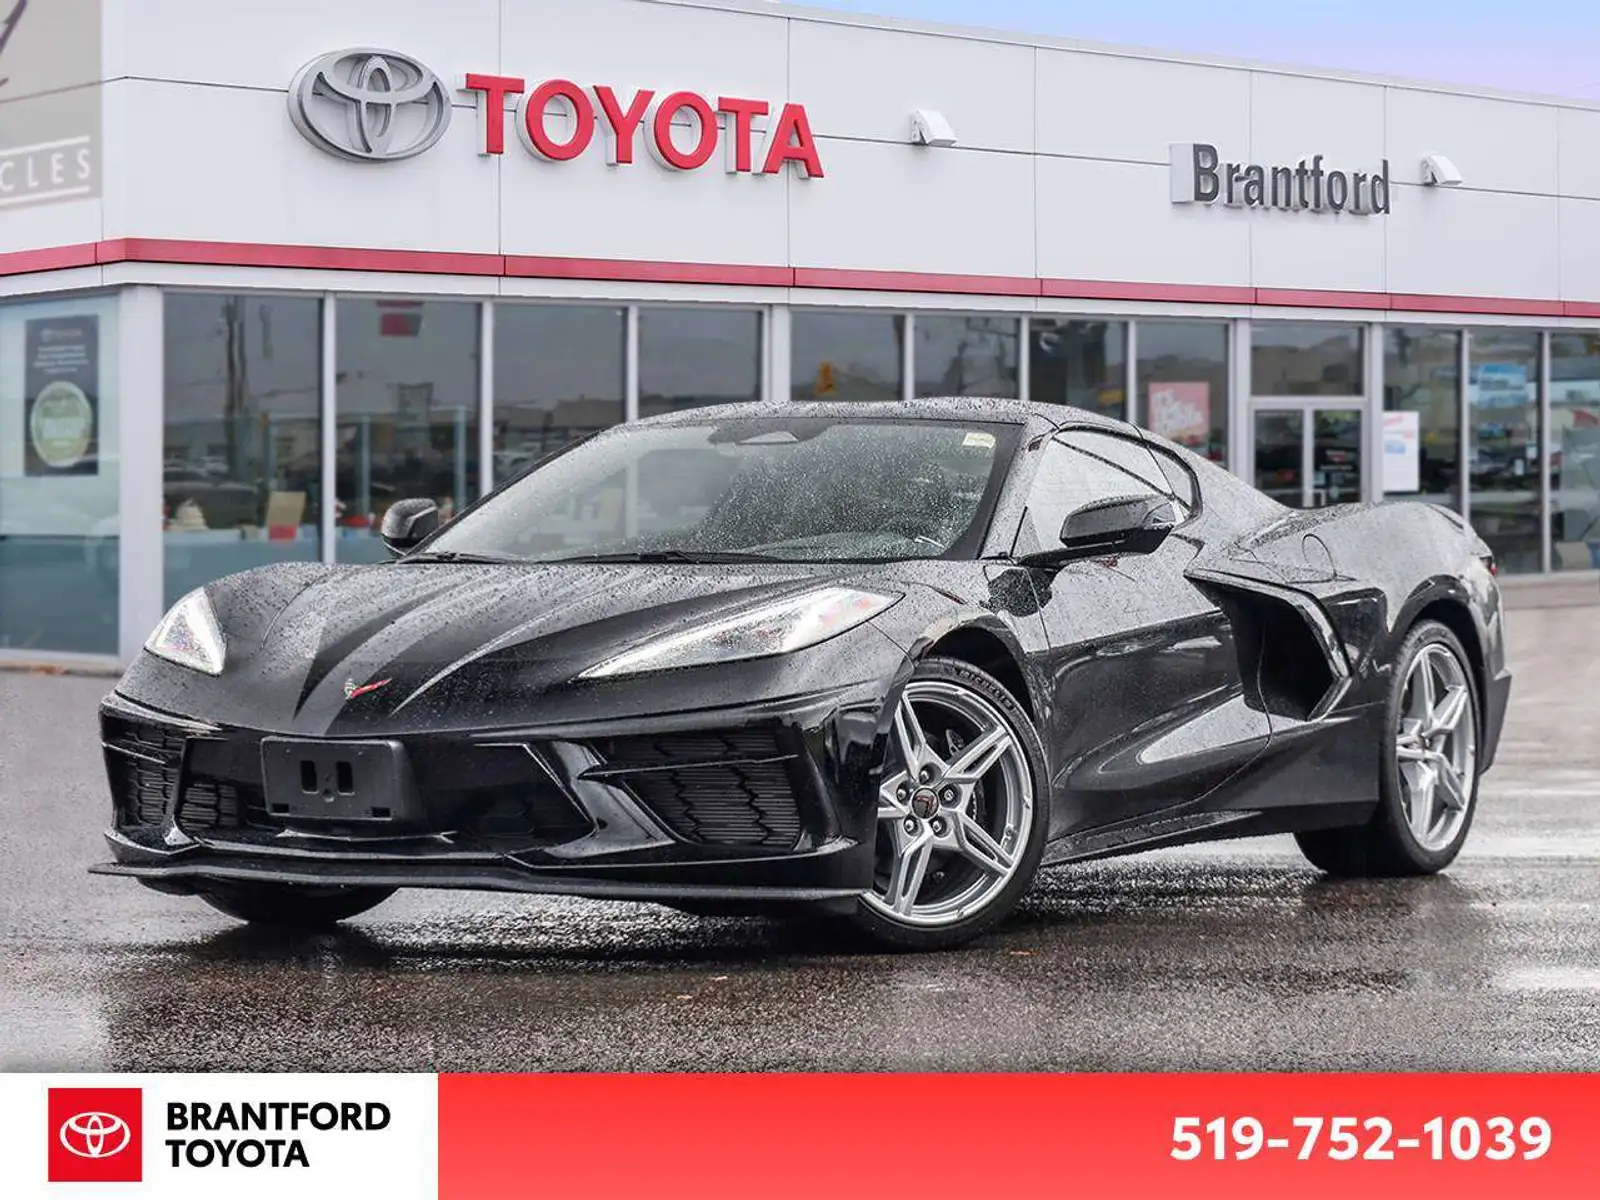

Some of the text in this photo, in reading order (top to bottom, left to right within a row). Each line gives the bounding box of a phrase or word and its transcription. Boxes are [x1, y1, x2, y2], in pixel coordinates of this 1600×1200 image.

[465, 73, 824, 178] TOYOTA
[0, 149, 91, 192] CLES
[1193, 143, 1390, 215] Brantford
